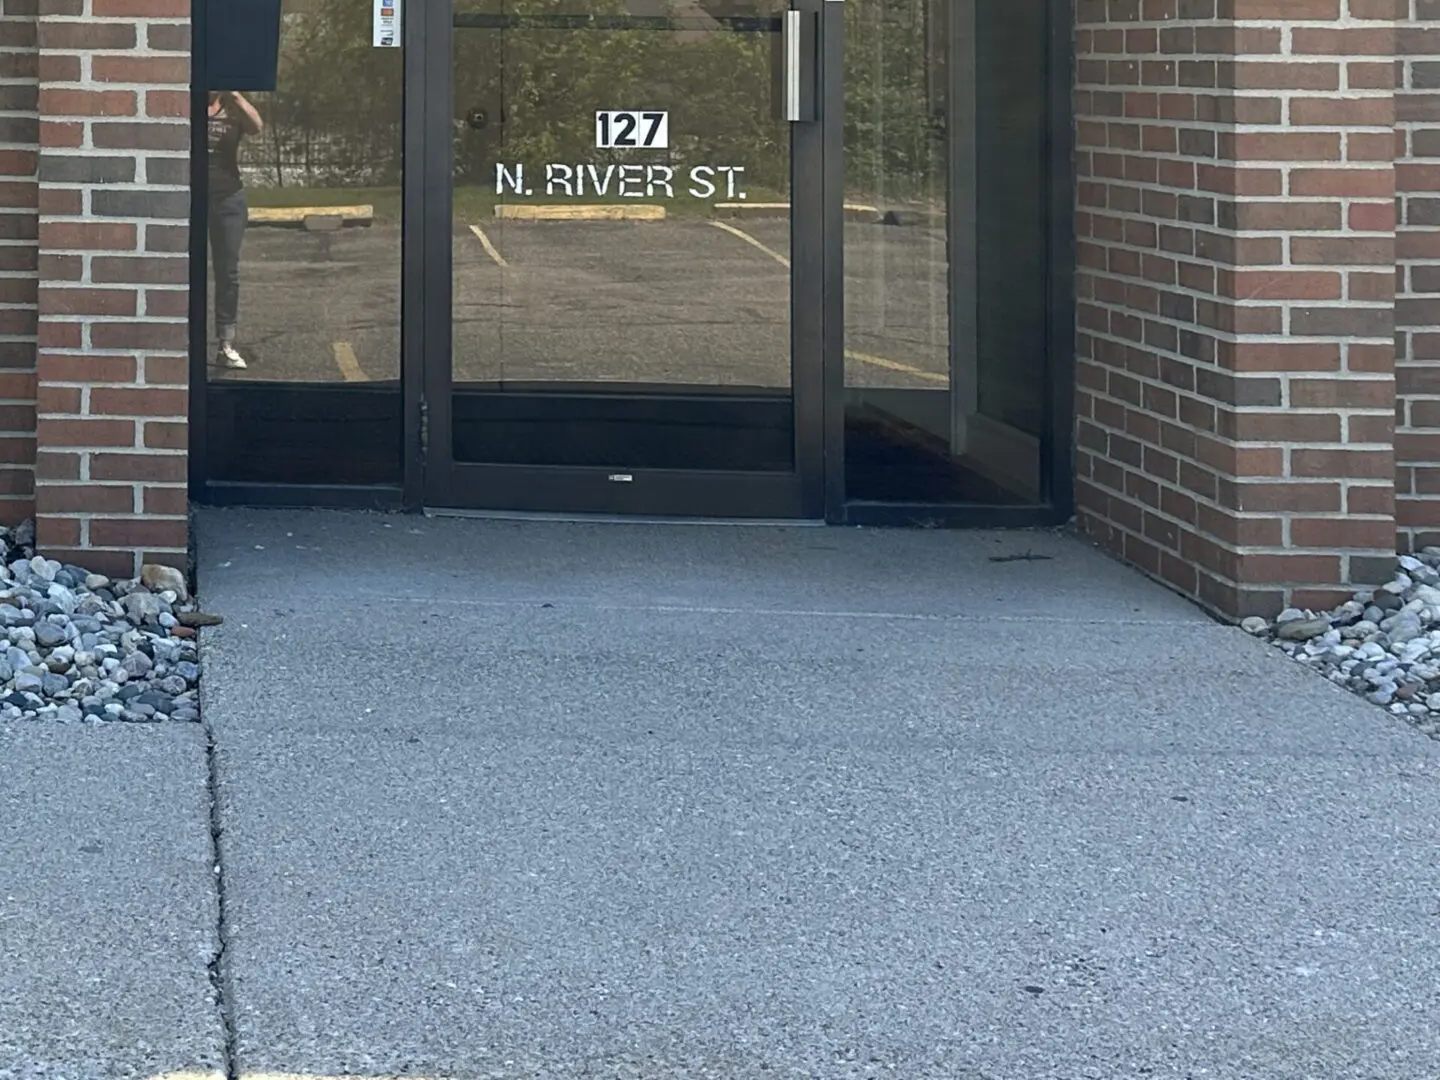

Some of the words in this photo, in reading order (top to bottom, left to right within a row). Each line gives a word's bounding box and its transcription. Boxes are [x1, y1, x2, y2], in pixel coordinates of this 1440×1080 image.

[597, 112, 665, 146] 127
[496, 163, 533, 196] N.
[546, 163, 674, 198] RIVER
[689, 166, 747, 199] ST.
